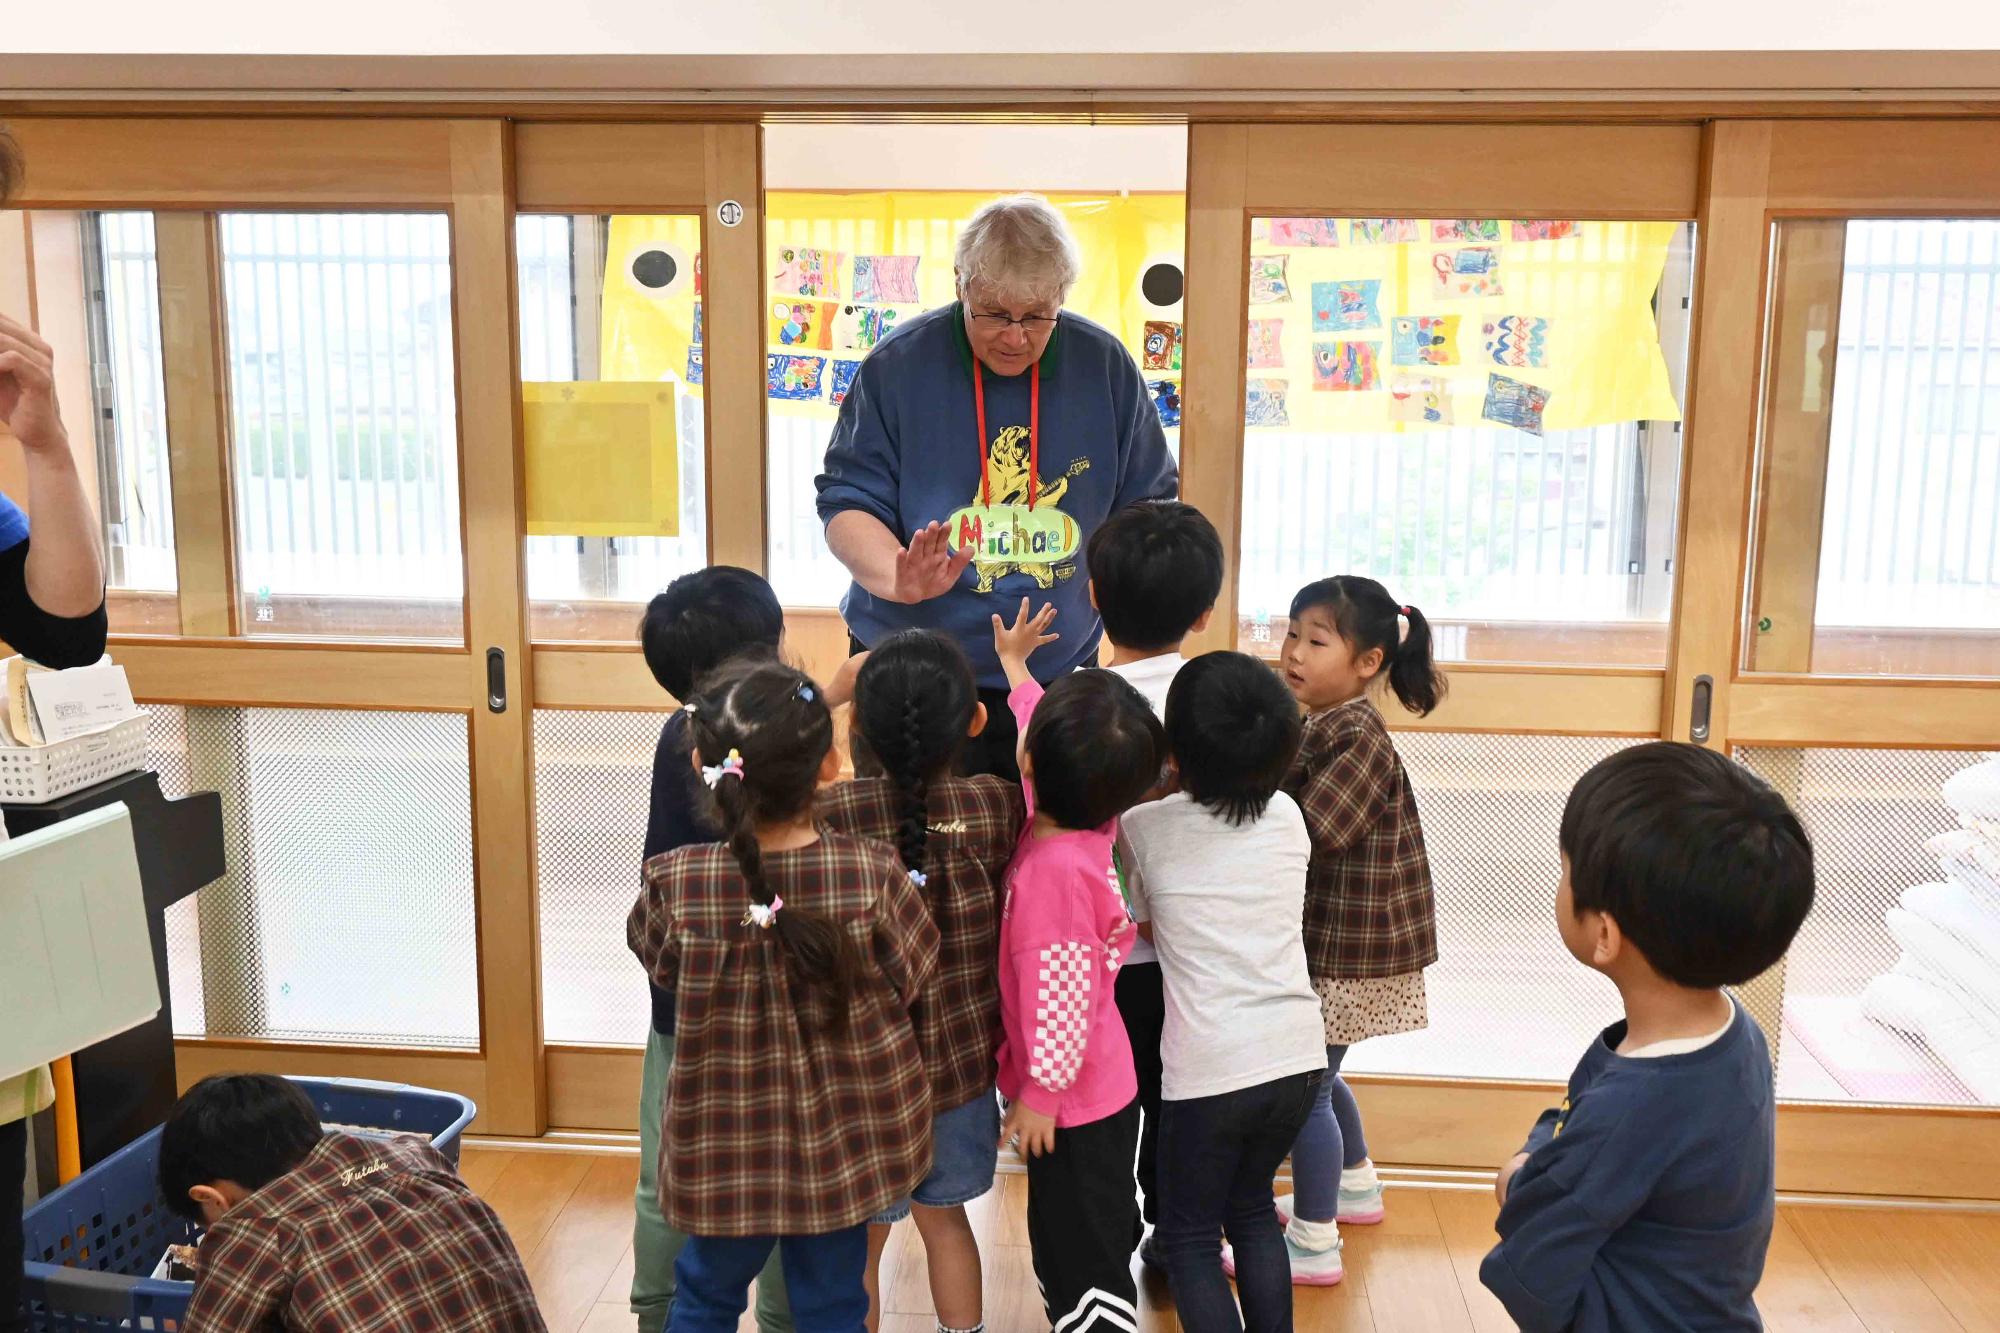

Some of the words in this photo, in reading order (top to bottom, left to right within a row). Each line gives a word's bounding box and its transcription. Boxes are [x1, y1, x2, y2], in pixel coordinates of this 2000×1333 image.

[959, 512, 1071, 555] Michael
[925, 819, 968, 834] taba
[341, 1159, 388, 1186] Futaba
